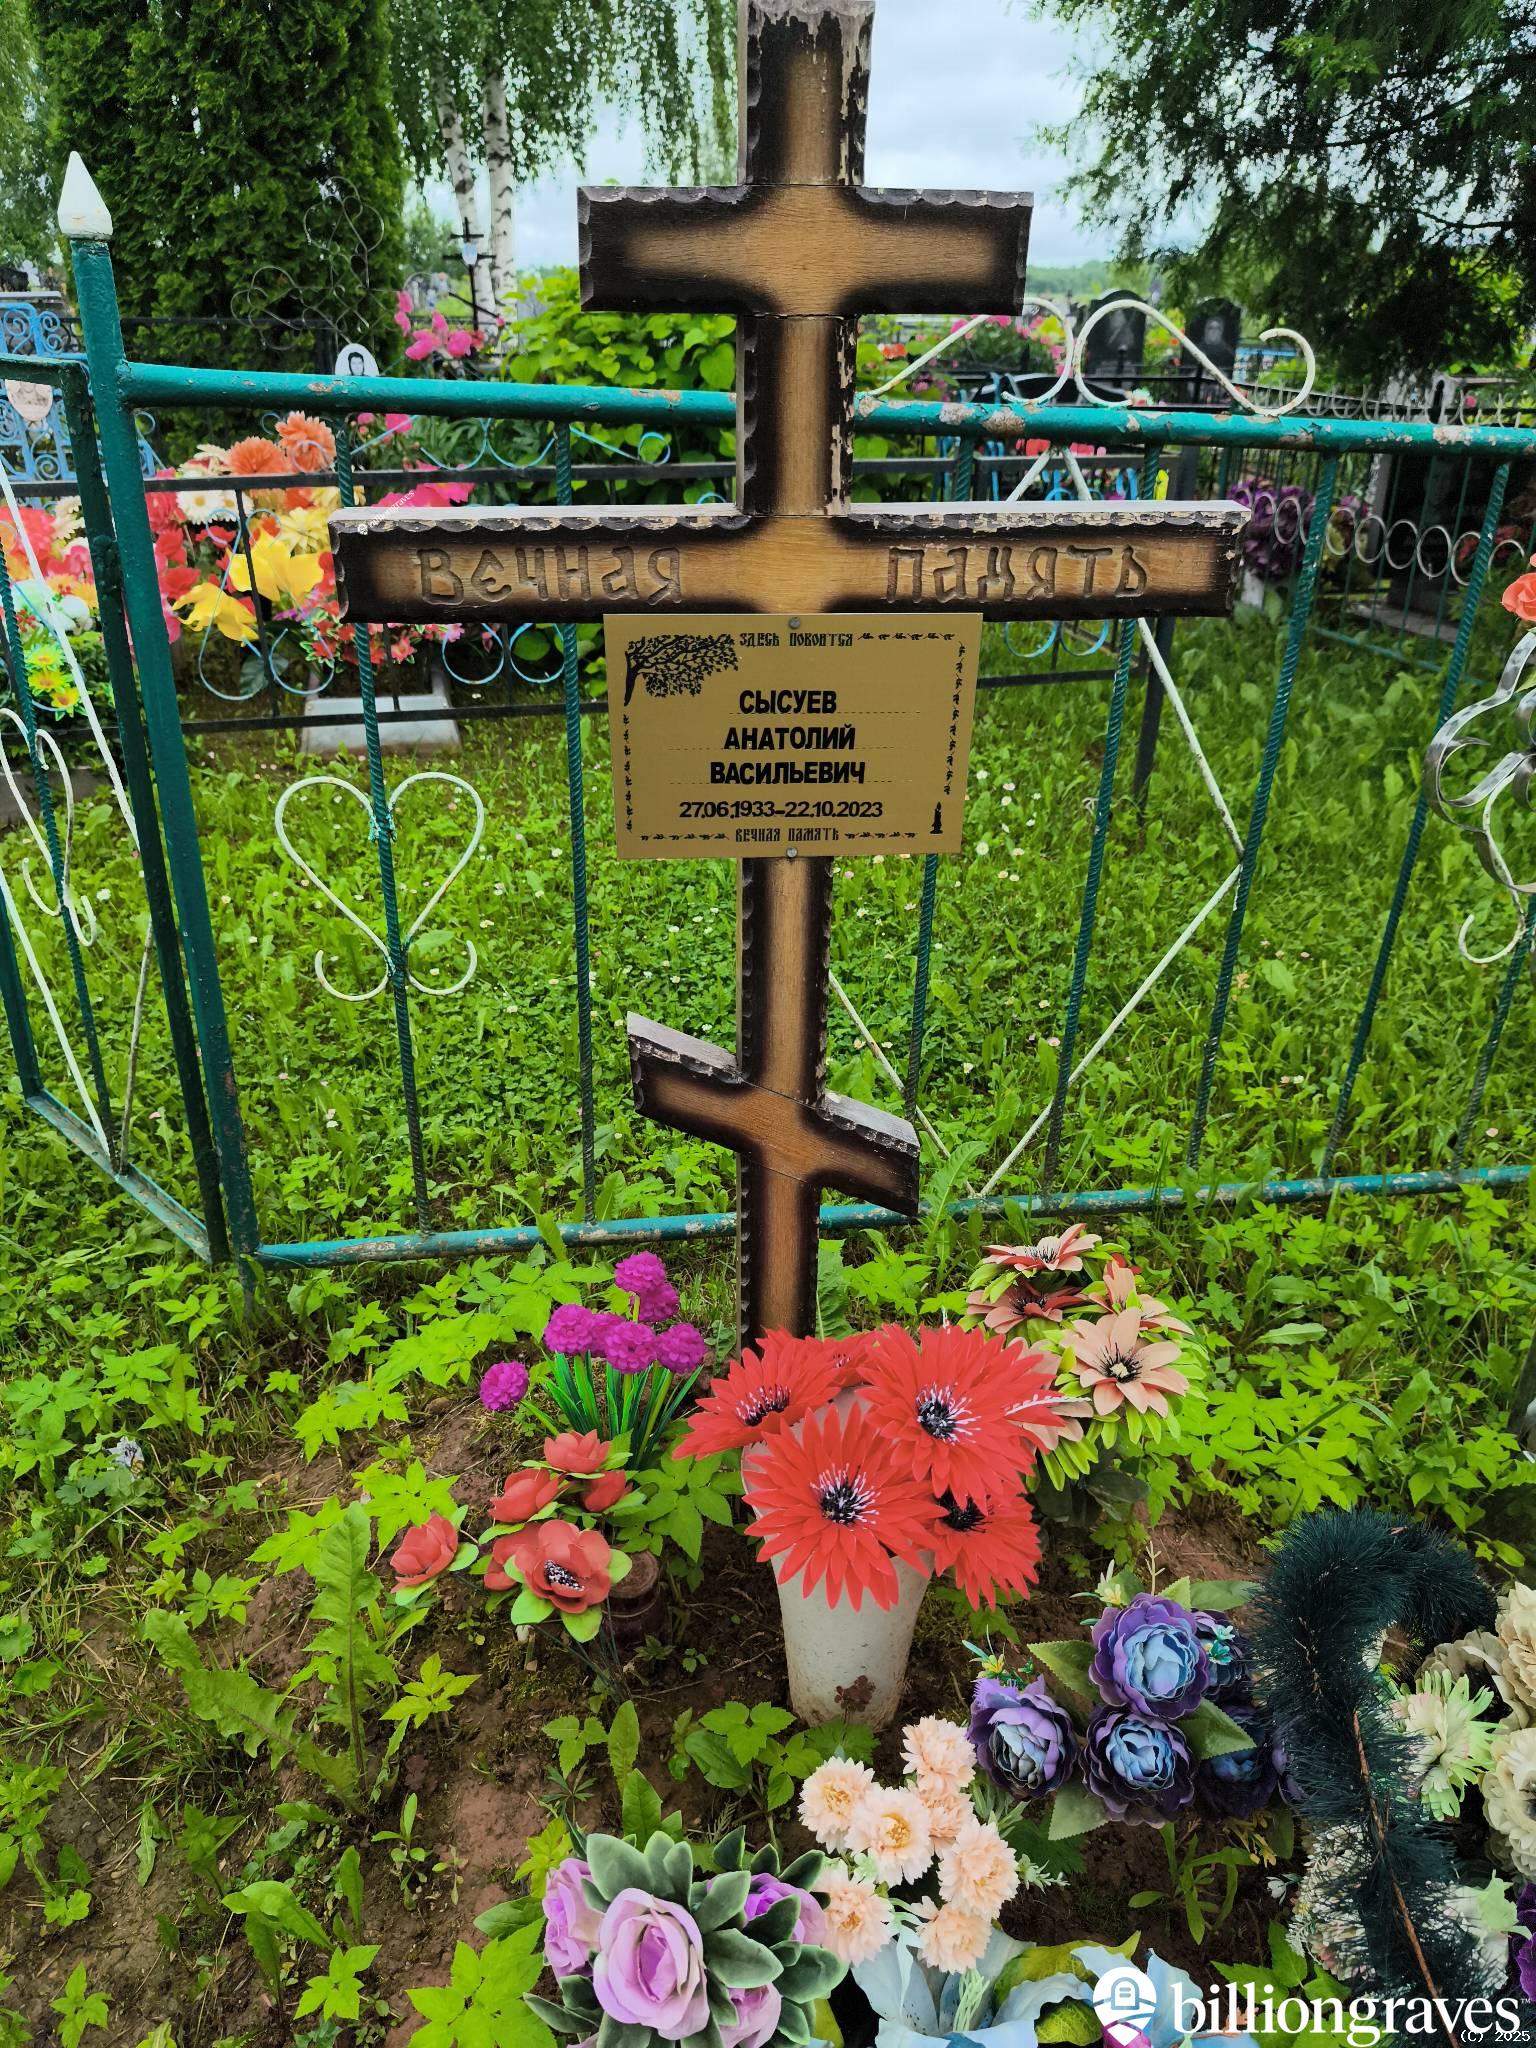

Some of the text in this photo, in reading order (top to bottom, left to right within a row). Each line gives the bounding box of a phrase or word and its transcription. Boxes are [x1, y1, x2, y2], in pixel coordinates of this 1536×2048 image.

[739, 632, 780, 648] ЗДЕСЬ
[739, 689, 837, 715] СЫСУЕВ
[724, 723, 856, 750] АНАТОЛИЙ
[710, 761, 866, 785] ВАСИЛЬЕВИЧ
[735, 827, 840, 842] ВЕЧНАЯ ПАМЯТЬ
